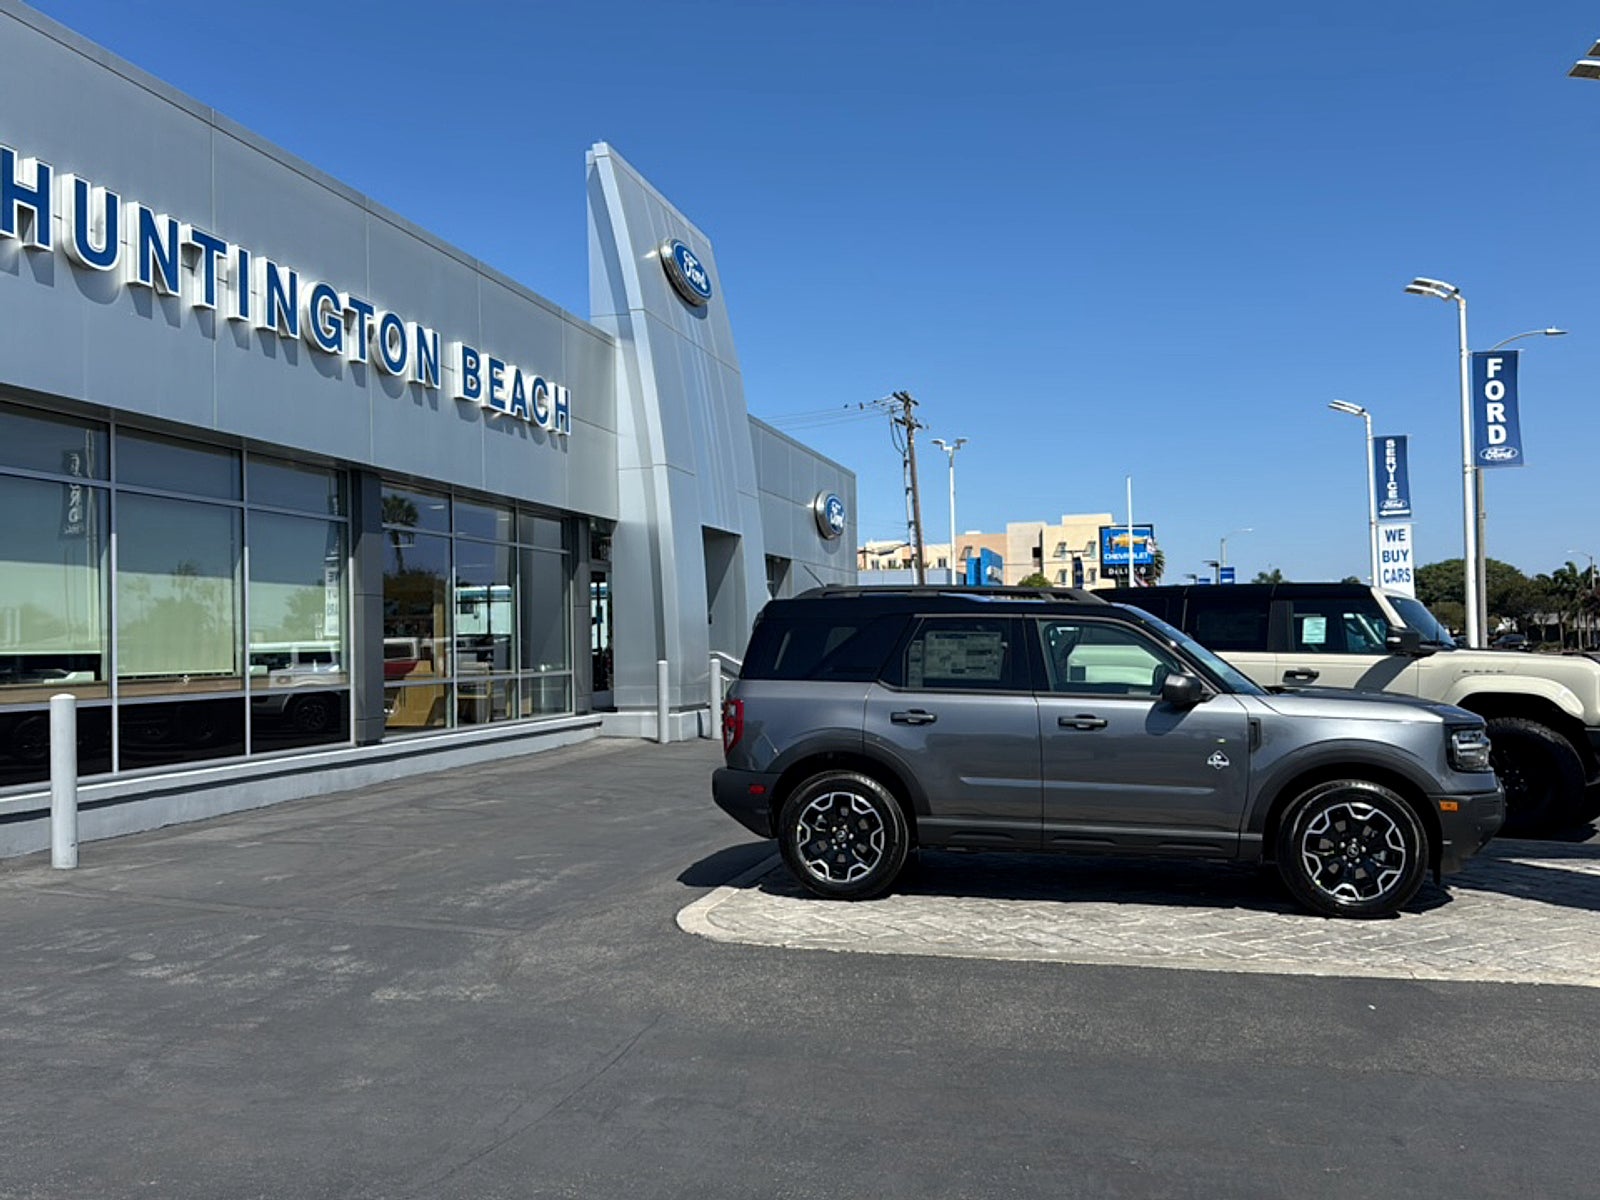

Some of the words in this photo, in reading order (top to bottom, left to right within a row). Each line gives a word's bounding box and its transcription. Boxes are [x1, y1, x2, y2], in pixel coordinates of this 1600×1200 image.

[681, 248, 708, 291] Ford
[0, 144, 441, 389] HUNTINGTON
[453, 341, 571, 436] BEACH
[1485, 358, 1507, 445] FORD
[1482, 447, 1515, 460] Ford
[1385, 438, 1398, 499] SERVICE
[1385, 528, 1406, 542] WE
[1382, 549, 1409, 562] BUY
[1384, 568, 1411, 583] CARS
